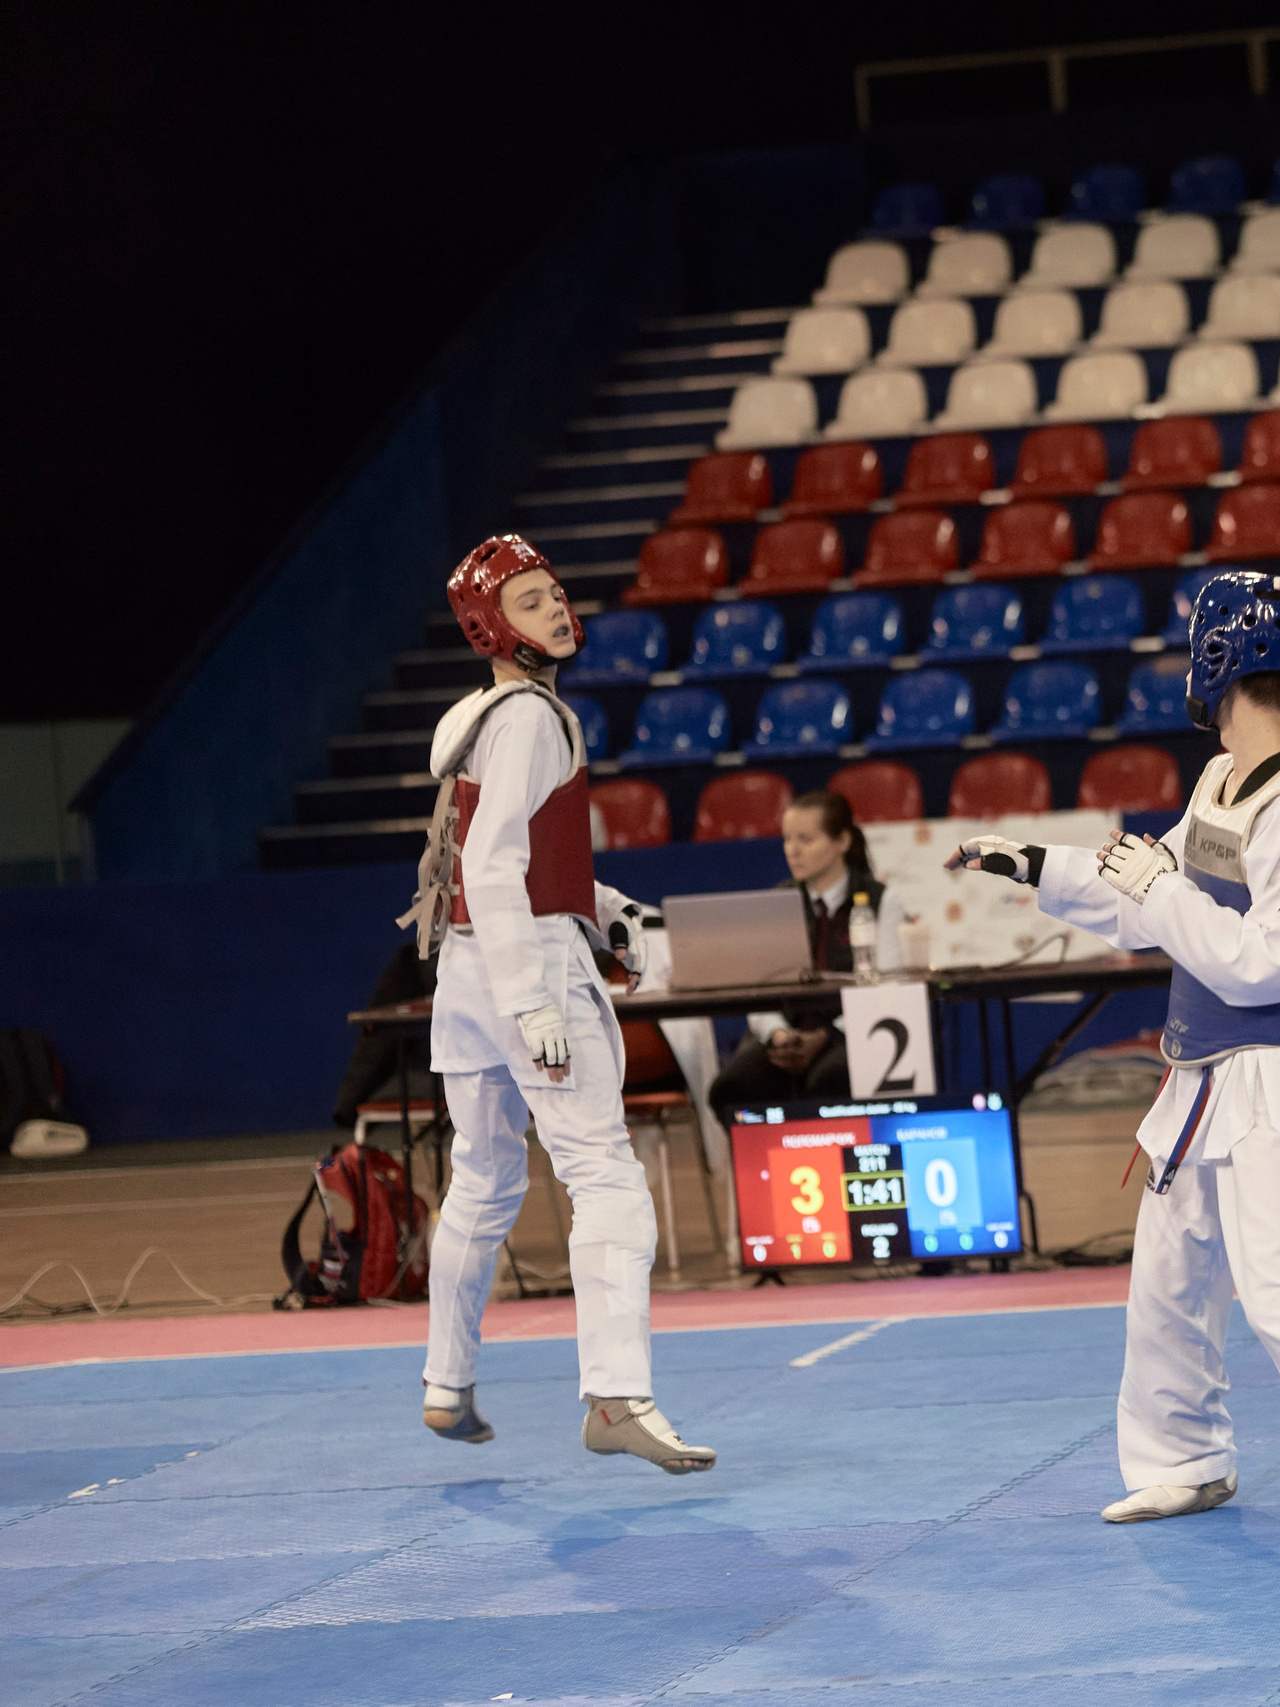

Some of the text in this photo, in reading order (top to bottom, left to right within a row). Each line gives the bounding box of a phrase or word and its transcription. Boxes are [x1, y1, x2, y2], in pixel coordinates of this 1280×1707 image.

[867, 1016, 917, 1094] 2
[790, 1166, 824, 1215] 3
[848, 1178, 902, 1206] 1:41
[924, 1158, 958, 1207] 0
[873, 1236, 891, 1259] 2
